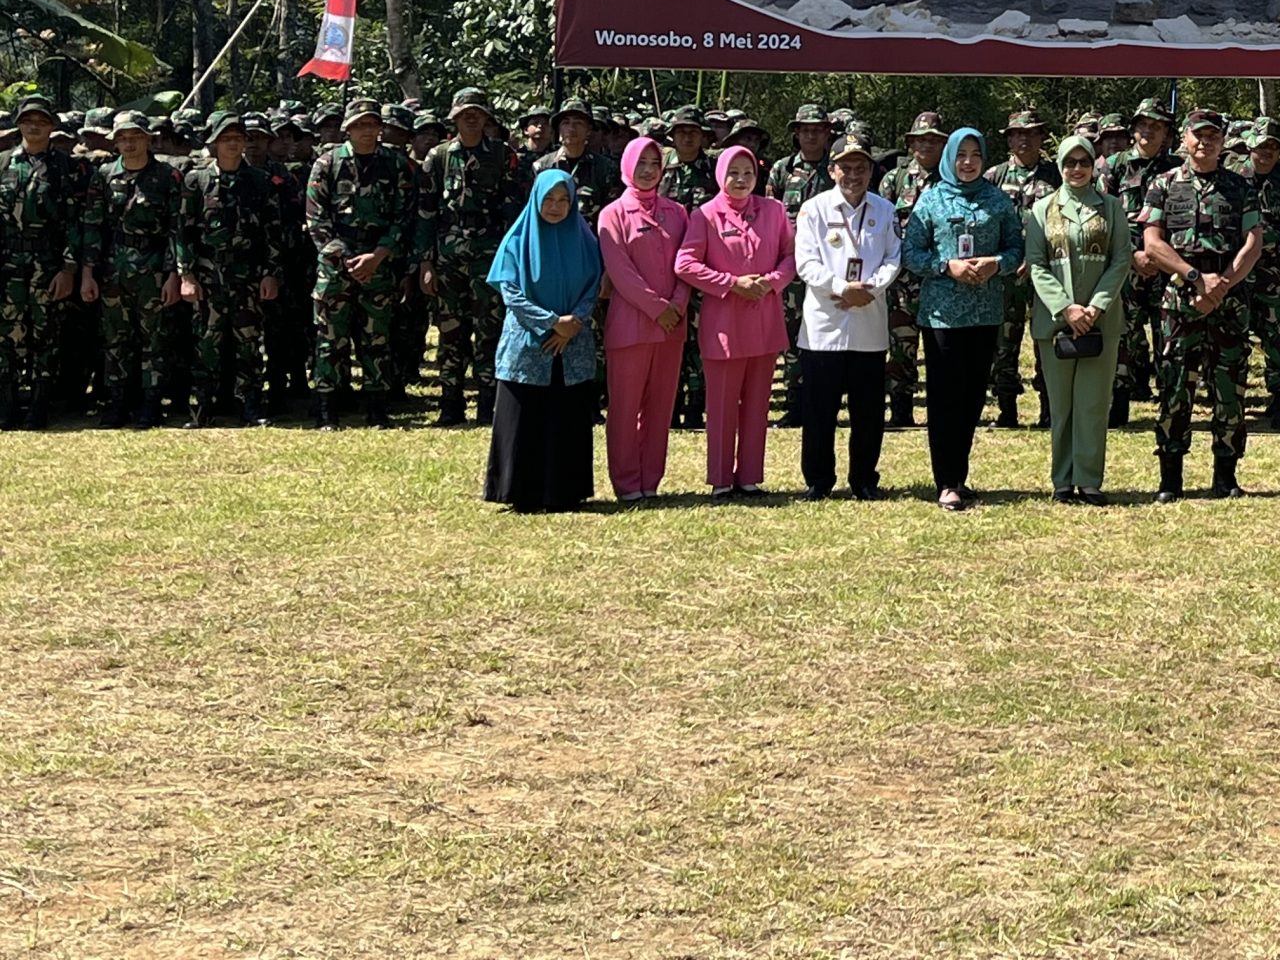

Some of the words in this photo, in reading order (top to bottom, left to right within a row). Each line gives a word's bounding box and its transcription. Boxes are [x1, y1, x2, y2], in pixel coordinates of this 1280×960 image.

[595, 30, 697, 50] Wonosobo,
[702, 33, 714, 48] 8
[719, 33, 753, 49] Mei
[757, 34, 802, 50] 2024
